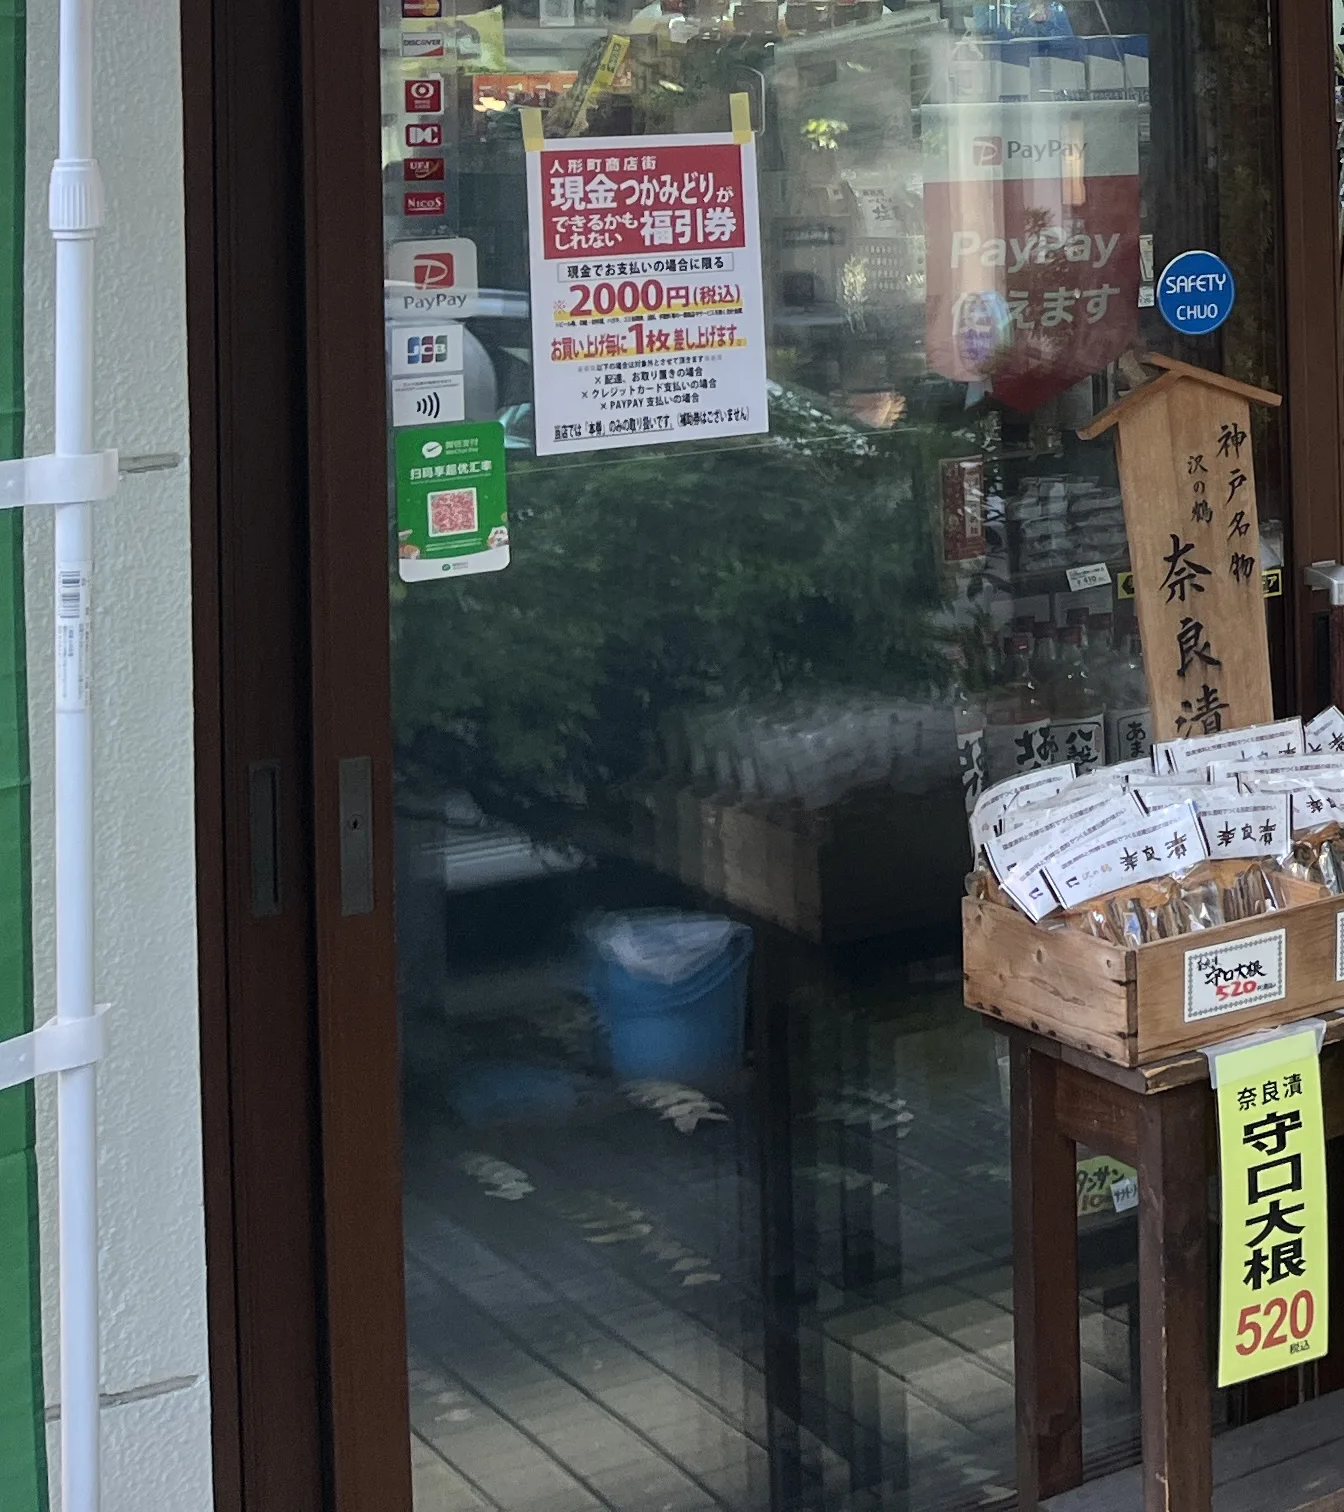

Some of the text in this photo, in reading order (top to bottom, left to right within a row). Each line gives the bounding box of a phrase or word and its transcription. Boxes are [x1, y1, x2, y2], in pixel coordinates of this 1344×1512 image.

[403, 38, 441, 48] DISCOVER
[408, 126, 439, 144] DC
[1007, 139, 1088, 161] PayPay
[549, 155, 657, 173] 人形町商店街
[552, 209, 639, 232] できるかも
[640, 206, 737, 246] 福引券
[554, 231, 623, 251] しれない
[950, 226, 1121, 272] PayPay
[566, 256, 725, 279] 現金でお支払いの場合に限る
[1165, 273, 1227, 295] SAFETY
[403, 293, 468, 310] PayPay
[1176, 303, 1218, 322] CHUO
[406, 343, 448, 356] JCB
[609, 392, 700, 410] PAYPAY 支払いの場合
[1186, 454, 1214, 526] 沢の鶴
[1214, 421, 1257, 584] 神戸名物
[1216, 818, 1278, 848] 奈良漬
[1119, 831, 1188, 873] 奈良漬
[1204, 960, 1266, 987] 守口大根
[1215, 980, 1257, 1002] 520
[1236, 1073, 1304, 1112] 奈良漬
[1242, 1109, 1308, 1291] 守口大根
[1235, 1288, 1315, 1357] 520
[1289, 1338, 1311, 1357] 税込
